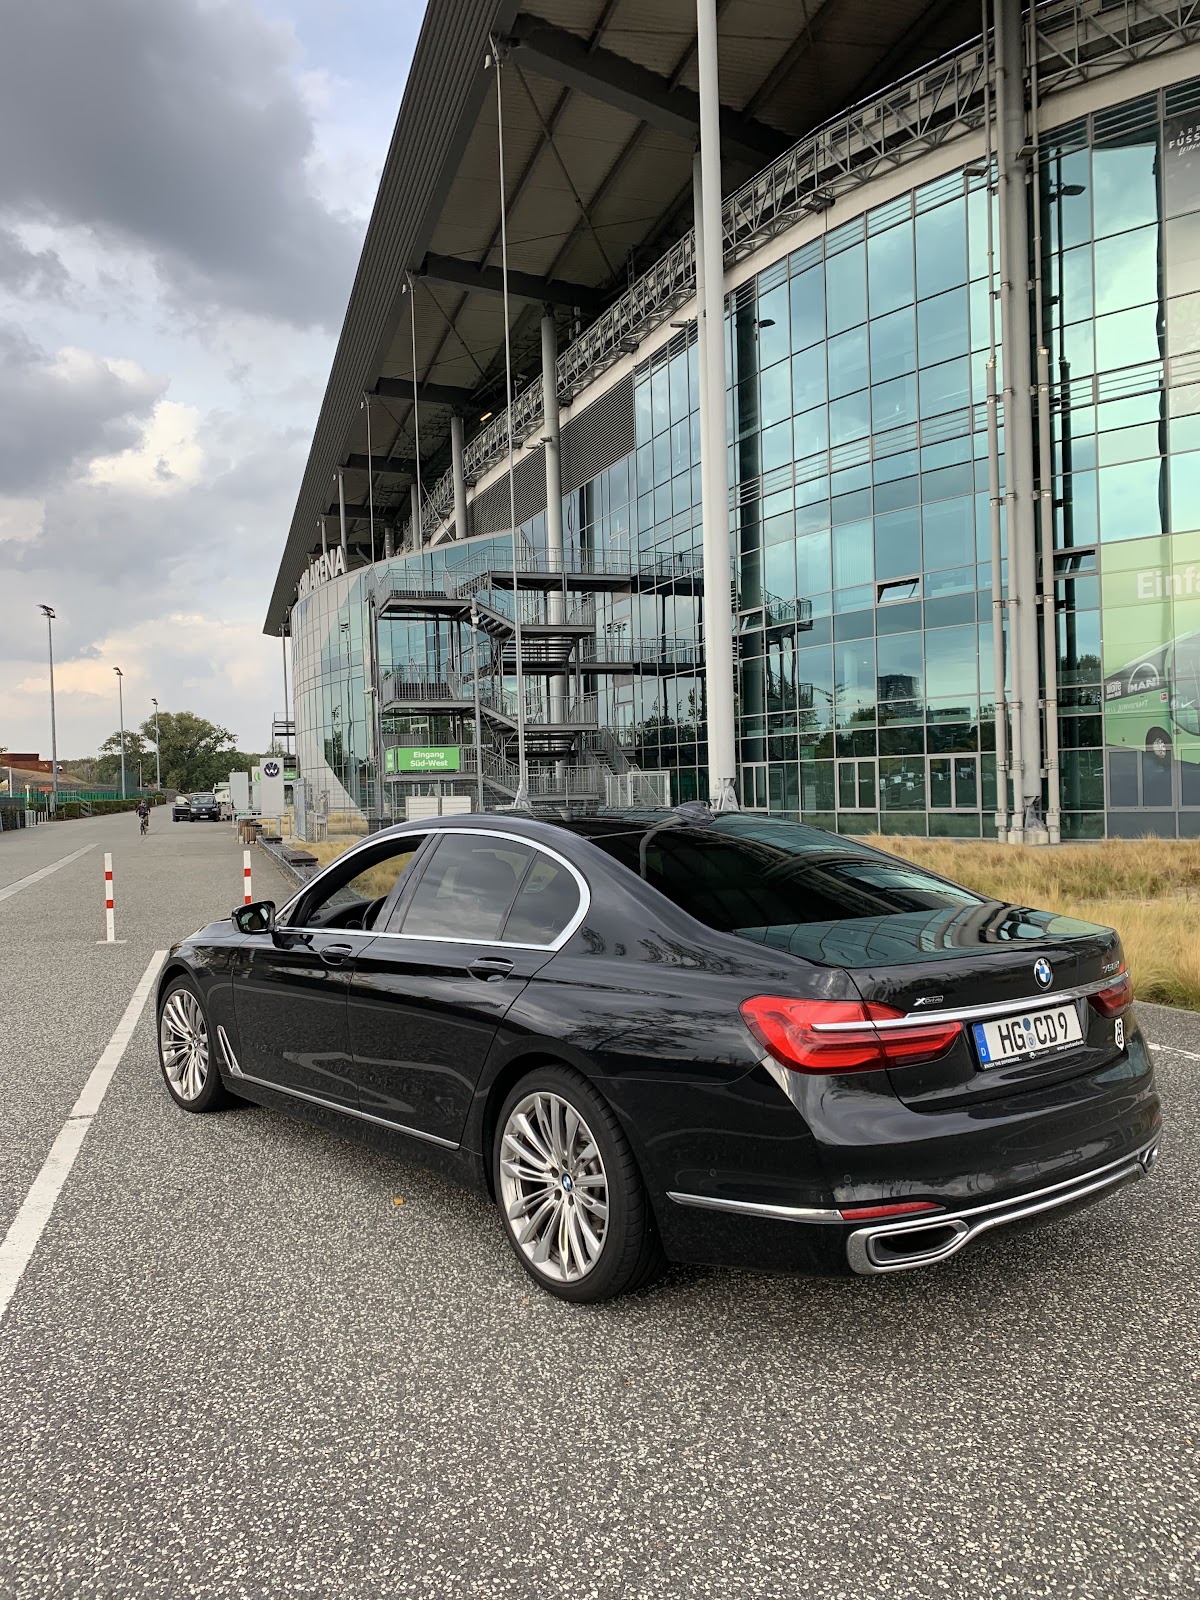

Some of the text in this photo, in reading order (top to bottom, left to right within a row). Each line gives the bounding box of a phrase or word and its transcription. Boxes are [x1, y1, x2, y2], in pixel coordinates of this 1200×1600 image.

[1130, 677, 1157, 692] MAN
[413, 751, 445, 759] Eingang
[998, 1012, 1068, 1054] HG CD 9
[980, 1047, 987, 1057] D
